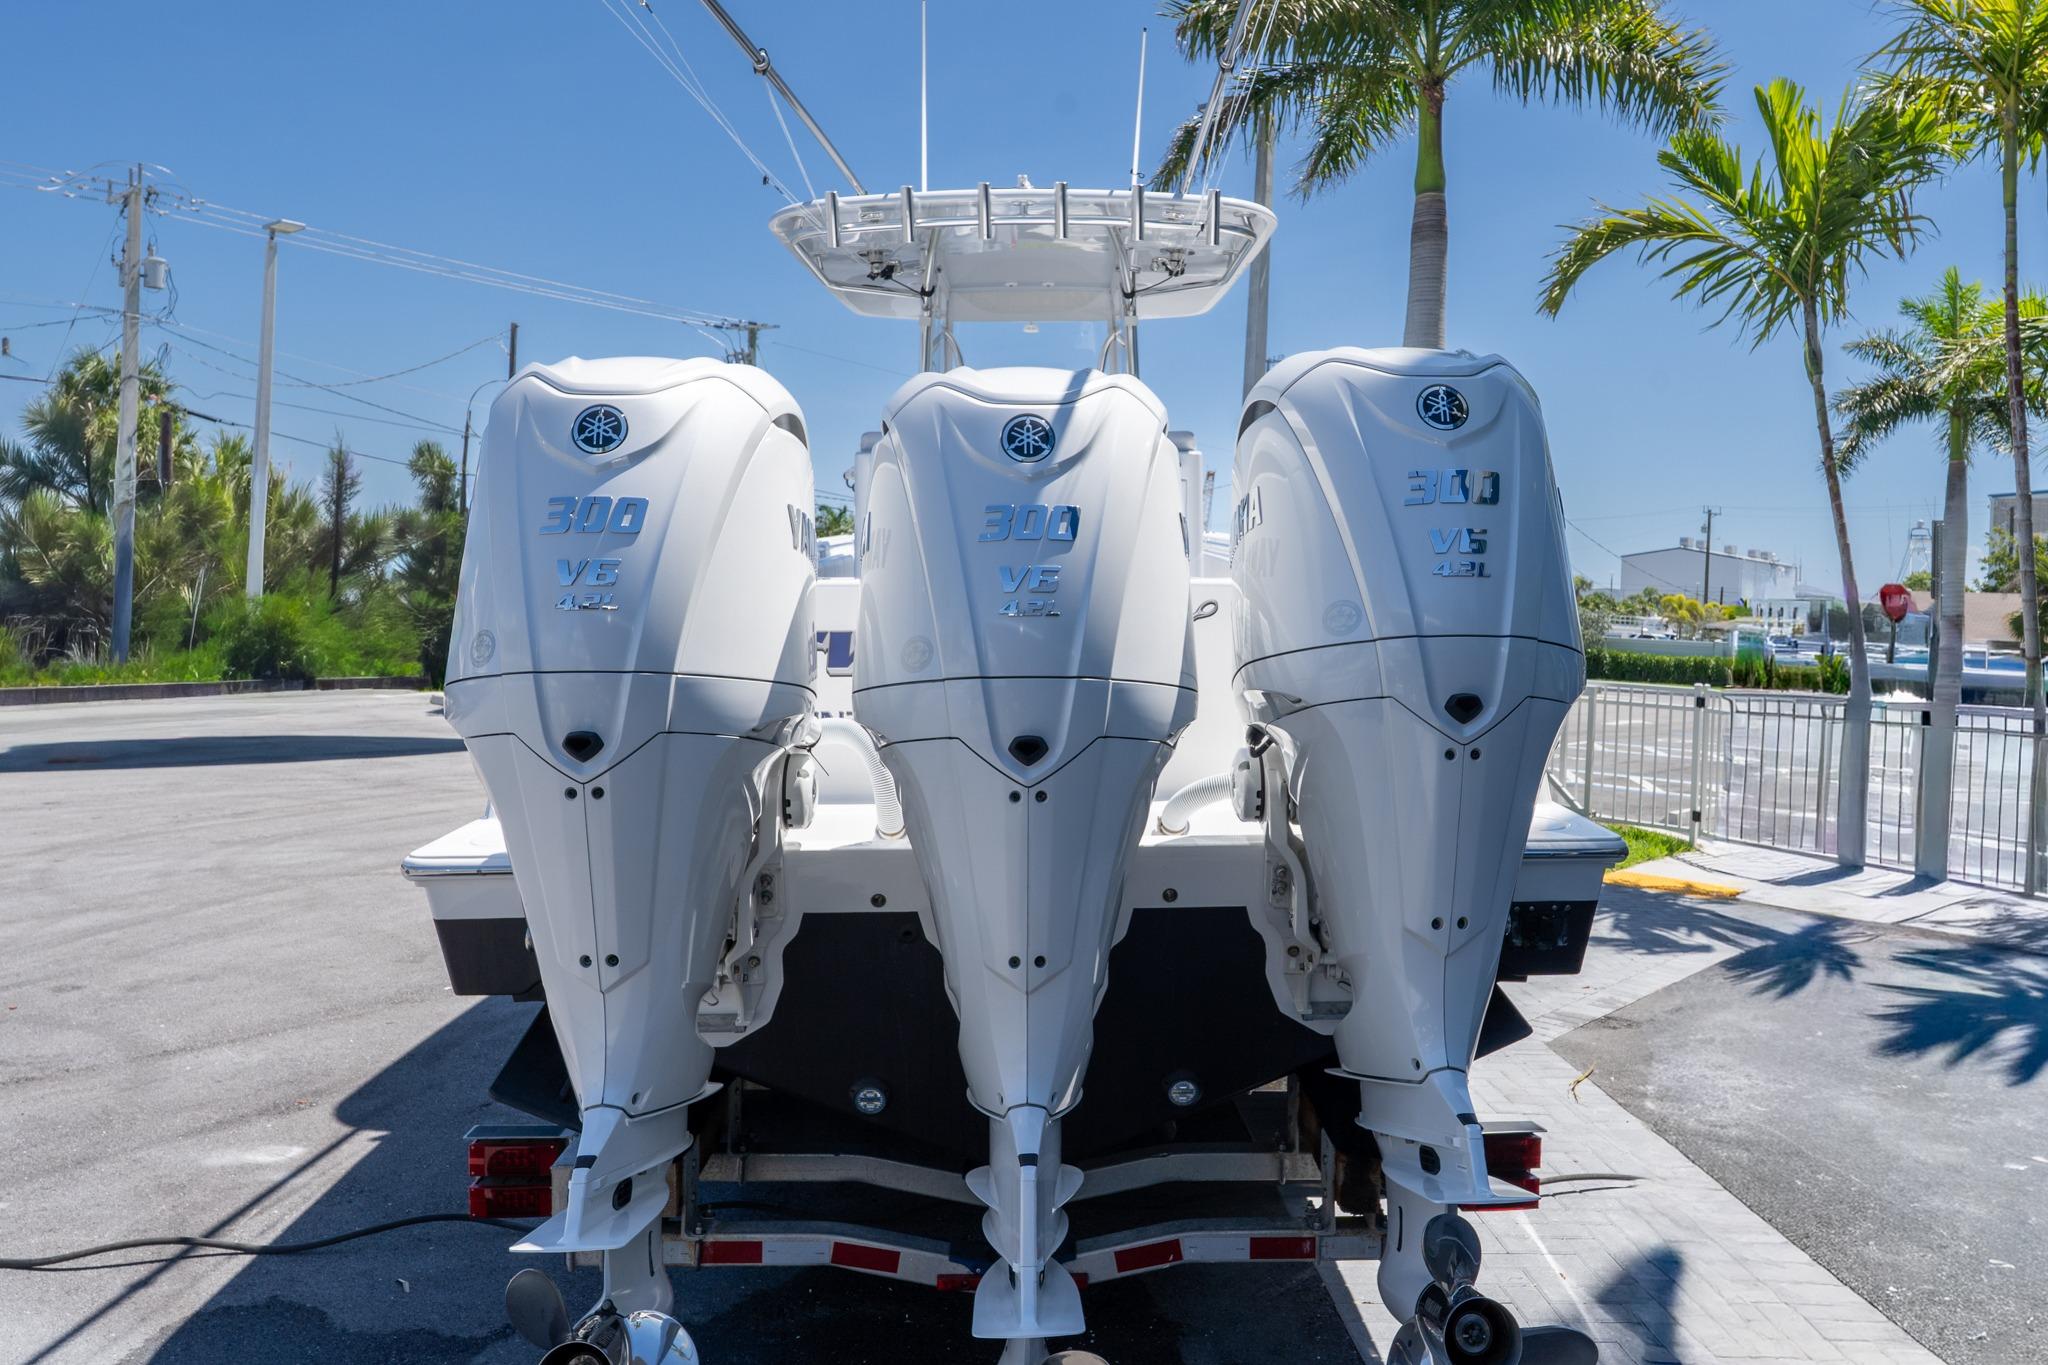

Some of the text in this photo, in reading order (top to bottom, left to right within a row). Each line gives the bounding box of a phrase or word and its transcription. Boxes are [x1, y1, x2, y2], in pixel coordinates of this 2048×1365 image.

[1404, 469, 1500, 506] 300
[539, 496, 649, 535] 300
[977, 504, 1081, 542] 300
[1430, 528, 1488, 554] V6
[556, 558, 621, 586] V6
[999, 565, 1061, 593] V6
